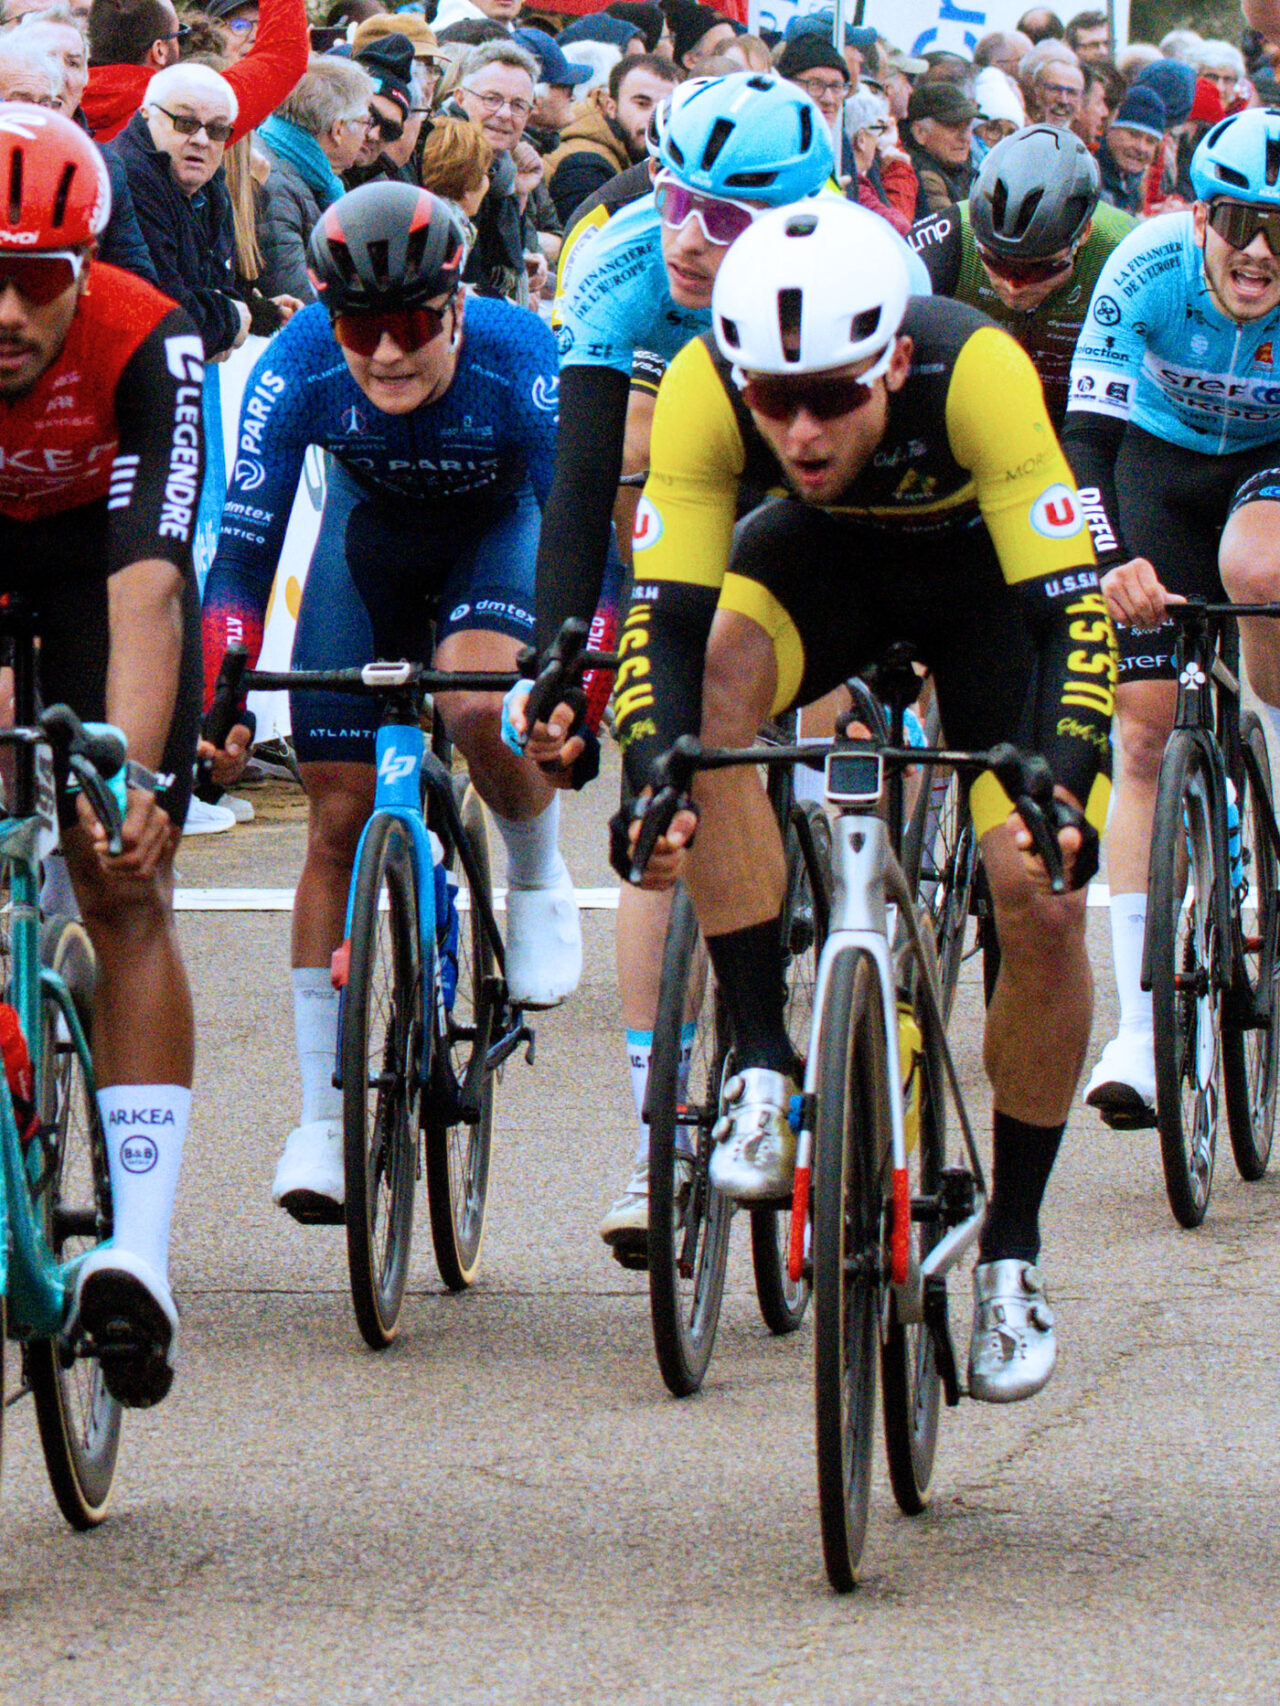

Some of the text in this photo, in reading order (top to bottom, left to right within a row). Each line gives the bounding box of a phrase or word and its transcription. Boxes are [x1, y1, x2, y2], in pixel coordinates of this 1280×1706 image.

[1127, 241, 1184, 273] FINANCIÈR
[1123, 279, 1140, 298] DE
[240, 369, 286, 455] PARIS
[158, 386, 200, 542] LEGENDRE
[476, 599, 537, 626] dmtex
[109, 1108, 175, 1125] ARKEA
